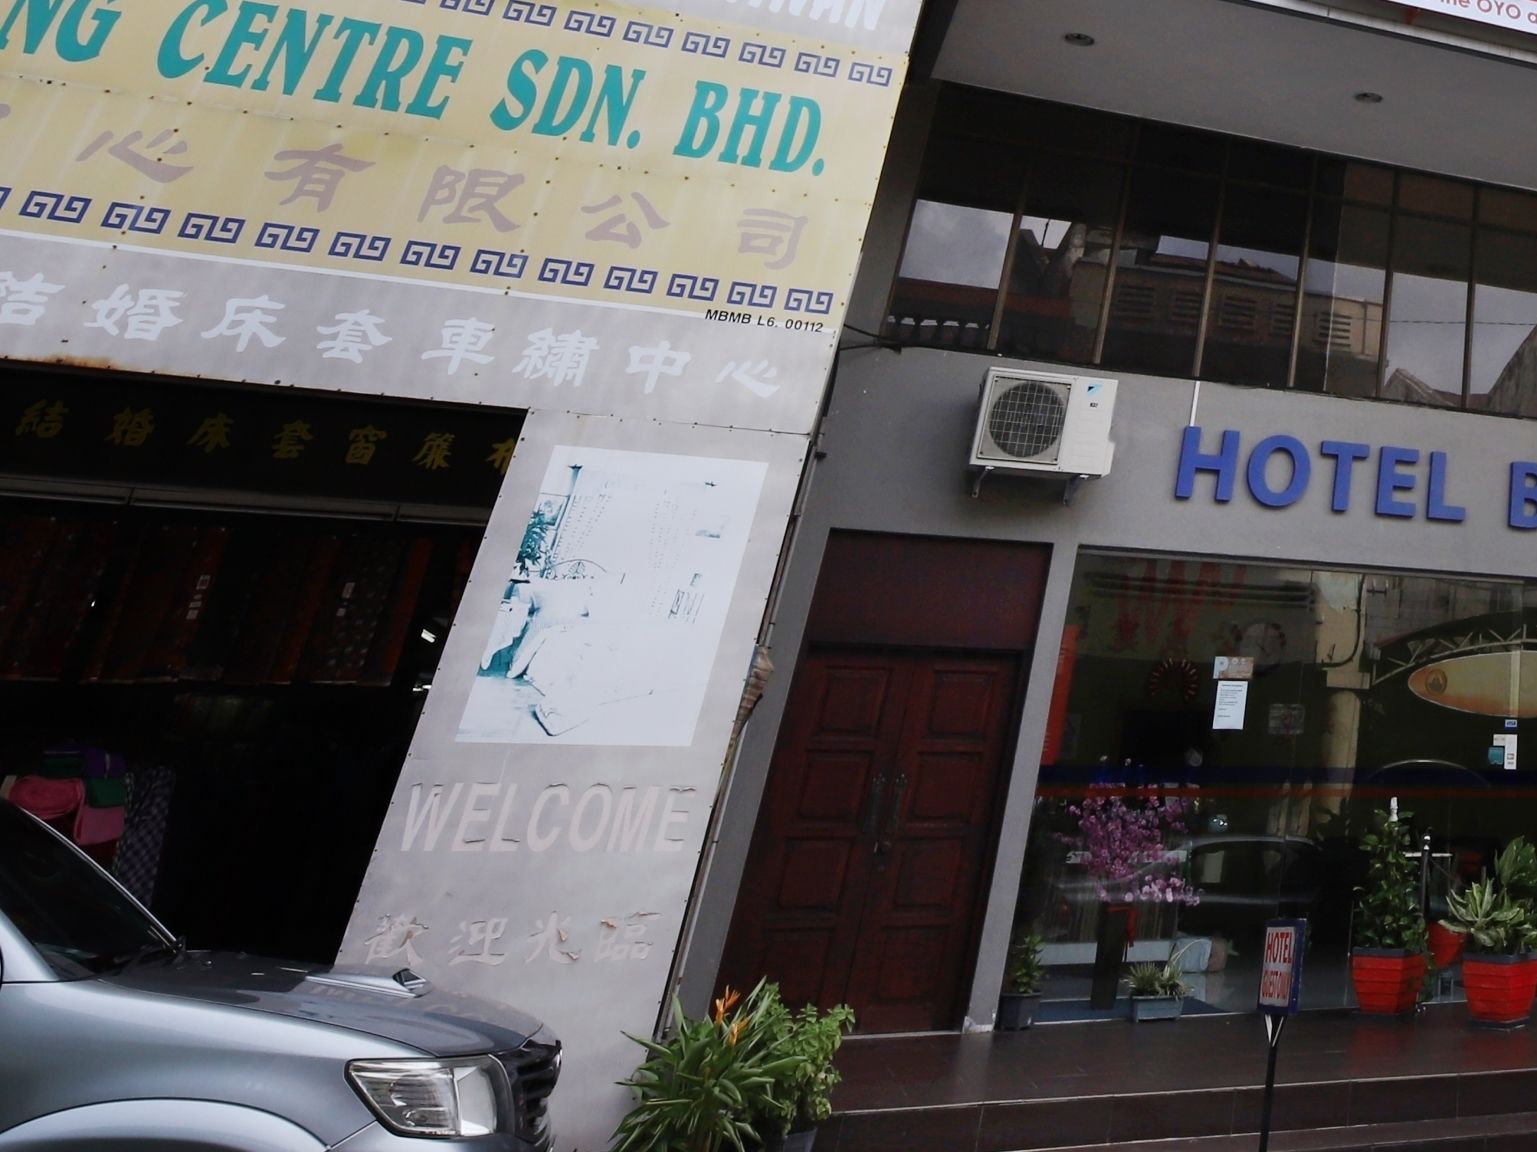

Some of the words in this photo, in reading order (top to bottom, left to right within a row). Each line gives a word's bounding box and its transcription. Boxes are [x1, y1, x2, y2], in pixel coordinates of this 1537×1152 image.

[489, 49, 647, 149] SDN.
[673, 79, 825, 177] BHD.
[0, 103, 813, 270] 心有限公司
[705, 309, 752, 324] MBMB
[785, 319, 824, 333] 00112
[1174, 424, 1466, 523] HOTEL
[400, 783, 696, 852] WELCOME
[1265, 932, 1293, 964] HOTEL
